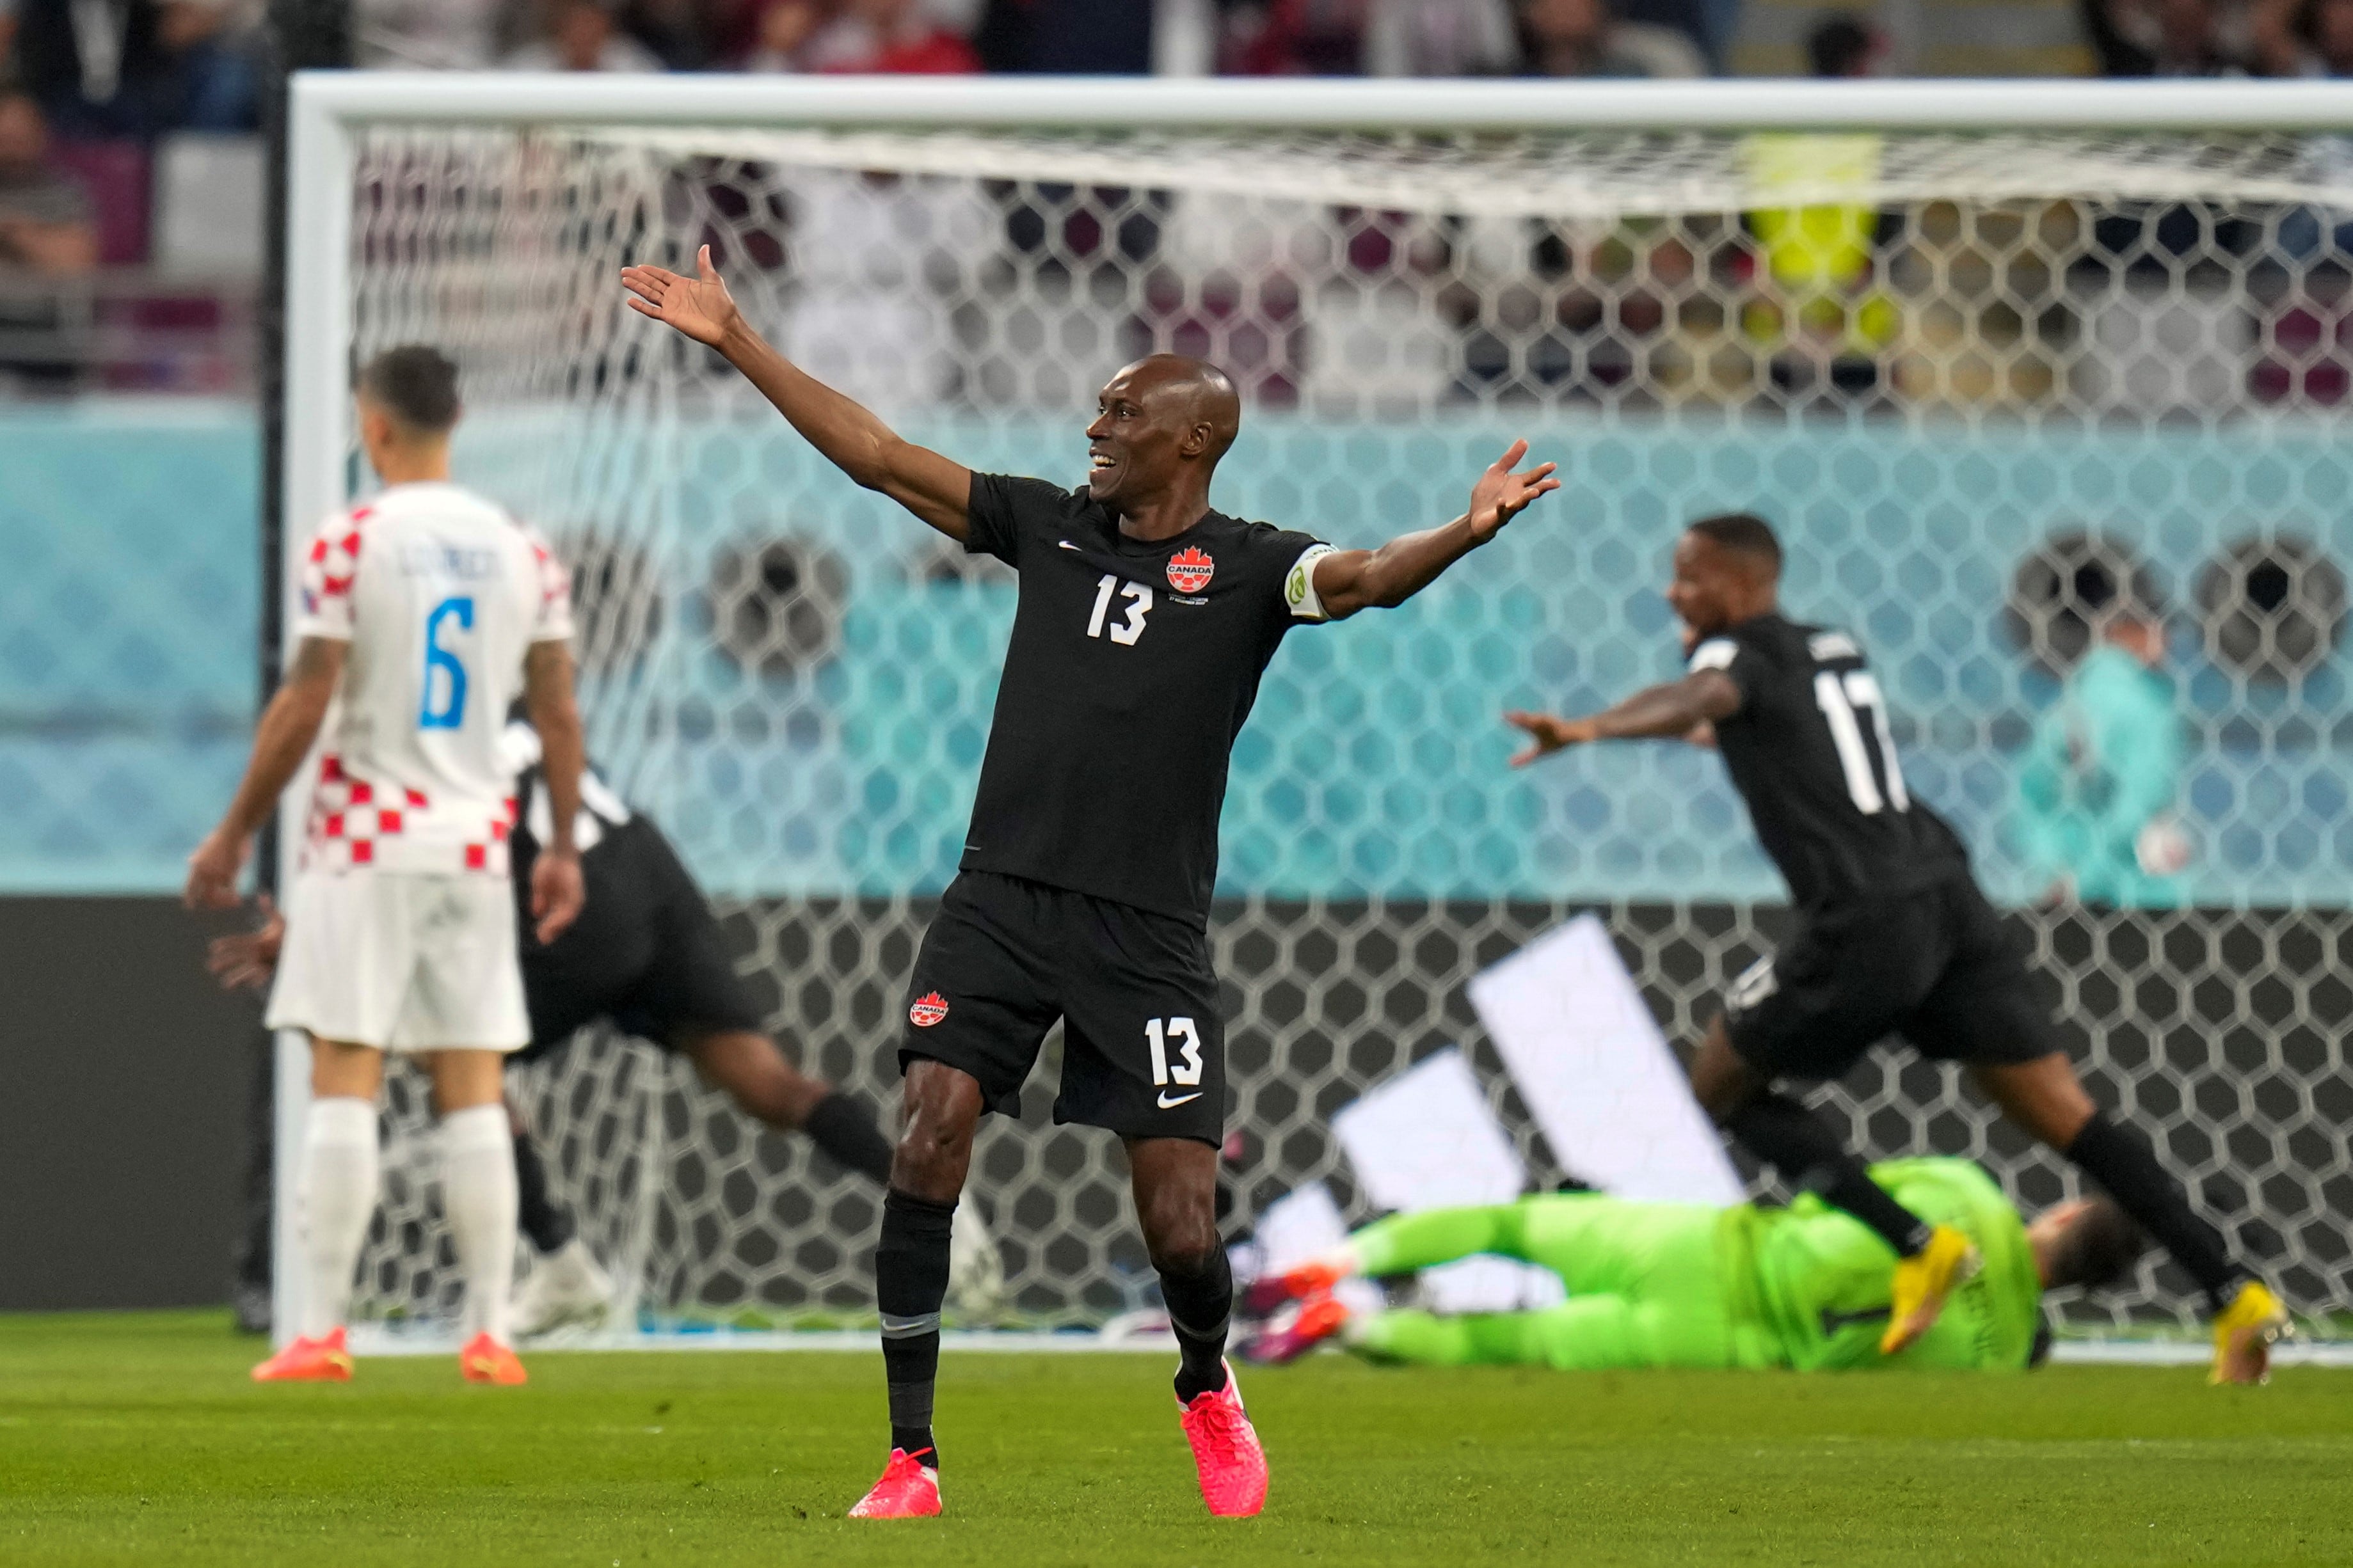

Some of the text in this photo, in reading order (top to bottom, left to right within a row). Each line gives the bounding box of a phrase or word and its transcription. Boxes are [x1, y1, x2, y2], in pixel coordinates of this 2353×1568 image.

[1168, 566, 1211, 574] CANADA
[1087, 574, 1153, 645] 13
[419, 596, 474, 729] 6
[1812, 669, 1910, 815] 17
[912, 1005, 945, 1015] CANADA
[1144, 1017, 1204, 1086] 13
